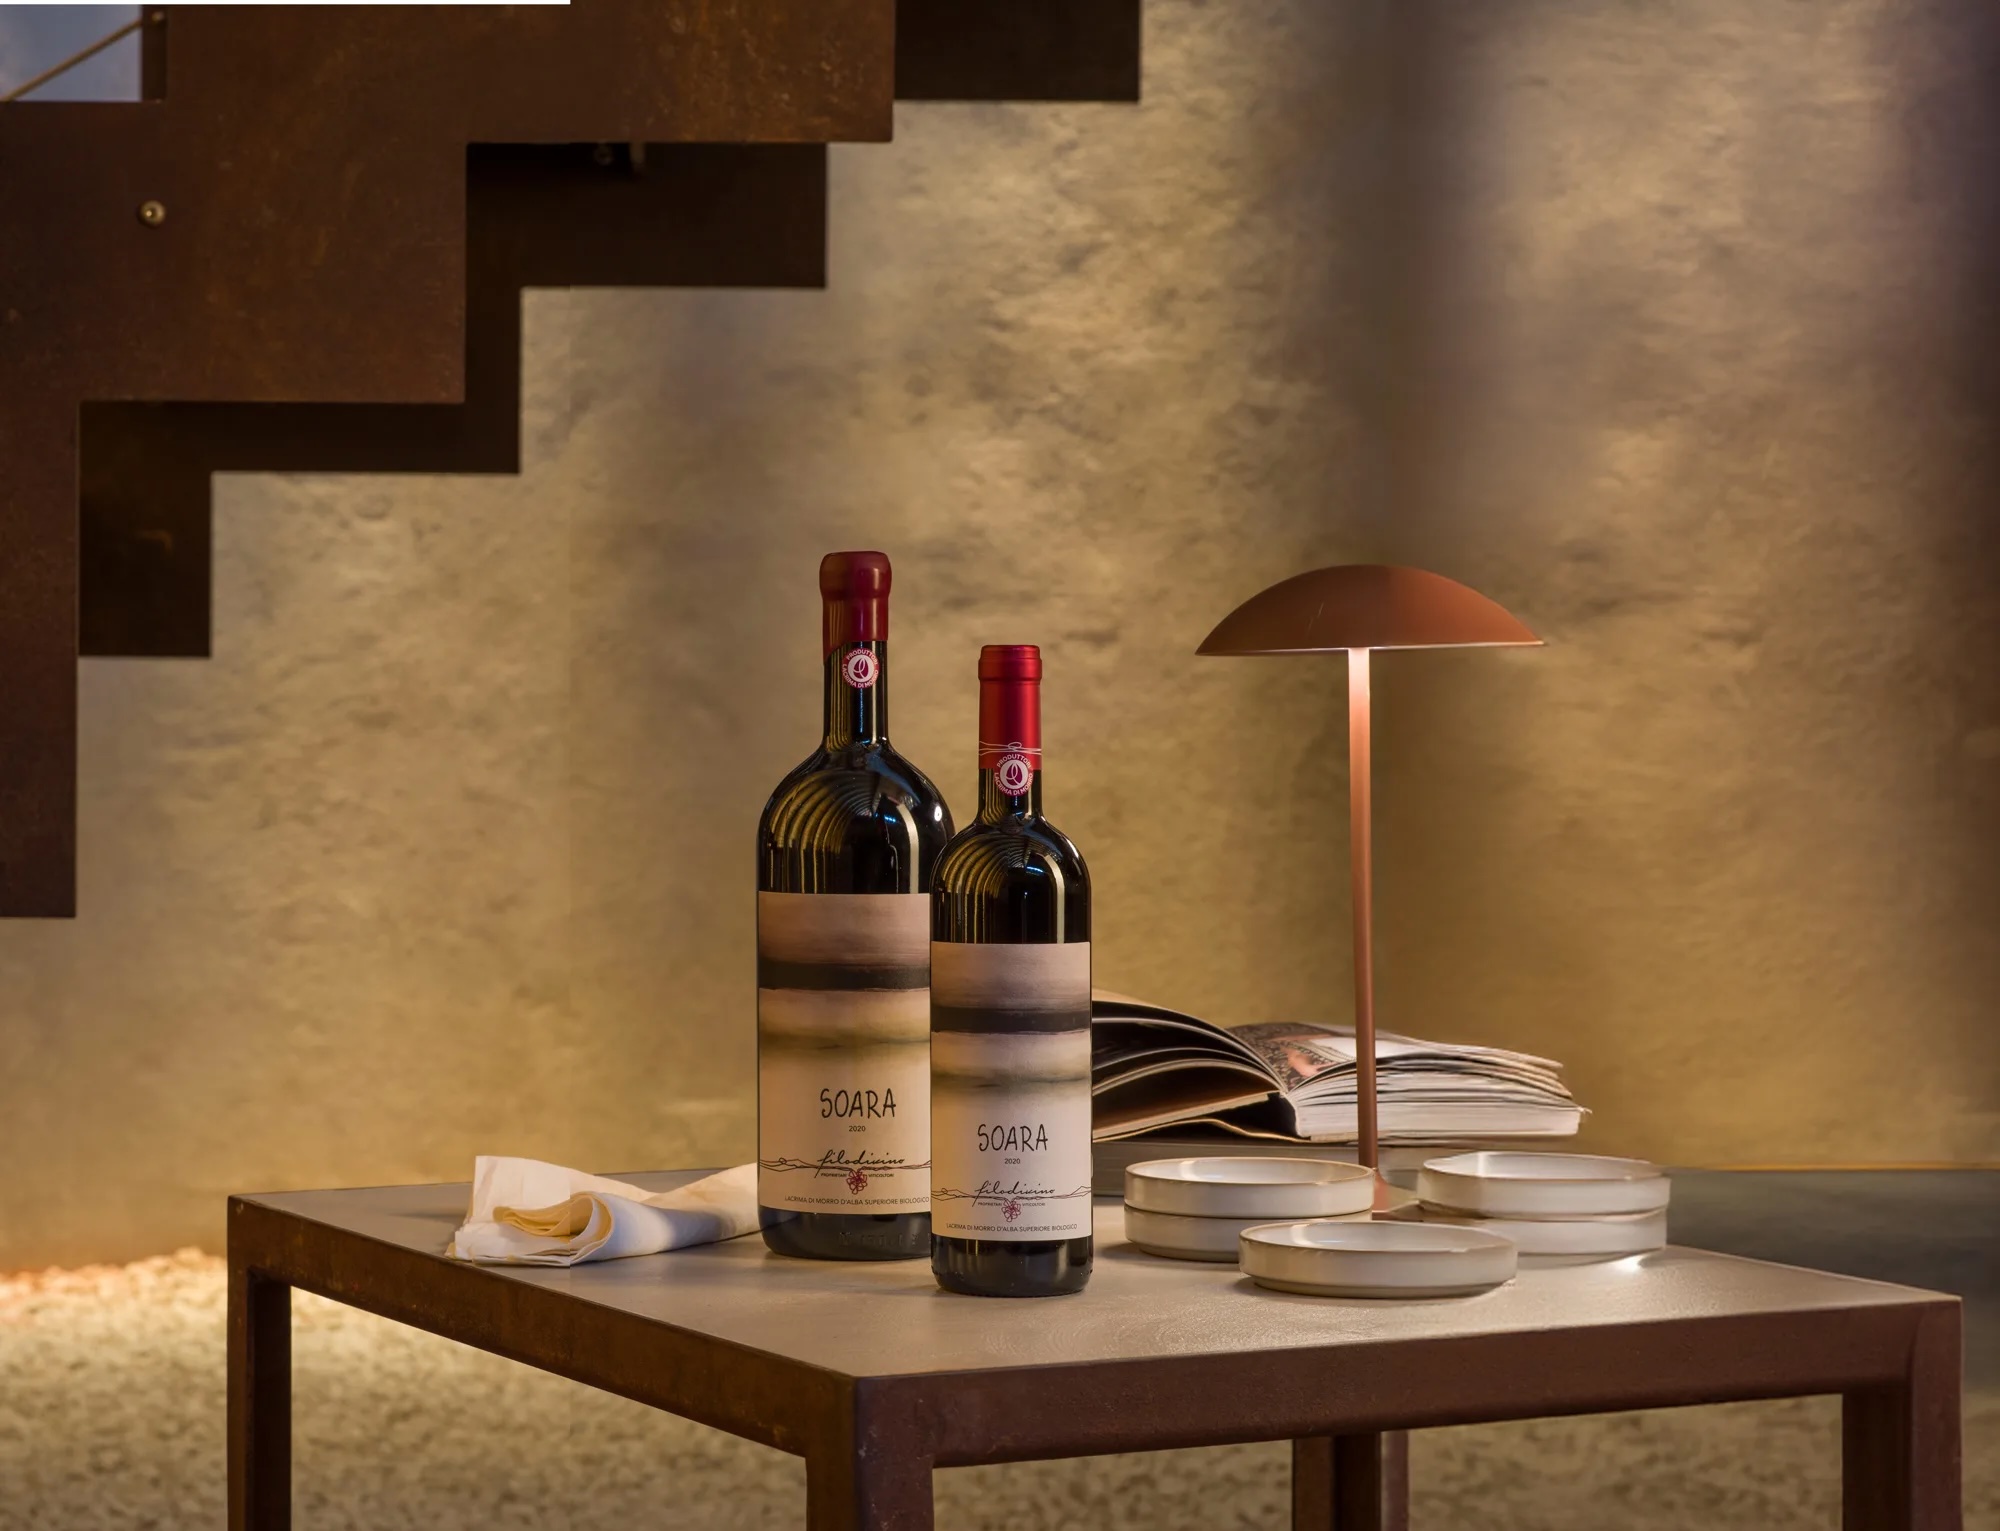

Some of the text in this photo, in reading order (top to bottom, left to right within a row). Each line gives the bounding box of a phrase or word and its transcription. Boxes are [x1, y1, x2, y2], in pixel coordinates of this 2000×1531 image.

[846, 649, 879, 665] PRODUTTORI
[842, 663, 857, 687] LACRIMA
[996, 754, 1032, 769] PRODUTTORI
[994, 772, 1012, 795] LACRIMA
[1020, 773, 1033, 795] MORRO
[820, 1088, 896, 1119] SOARA
[977, 1123, 1049, 1152] SOARA
[814, 1149, 905, 1178] filodivino
[784, 1195, 807, 1203] LACRIMA
[816, 1197, 839, 1205] MORRO
[899, 1196, 930, 1204] BIOLOGICO
[972, 1180, 1056, 1207] filodivino
[946, 1222, 966, 1230] LACRIMA
[1051, 1223, 1078, 1231] BIOLOGICO
